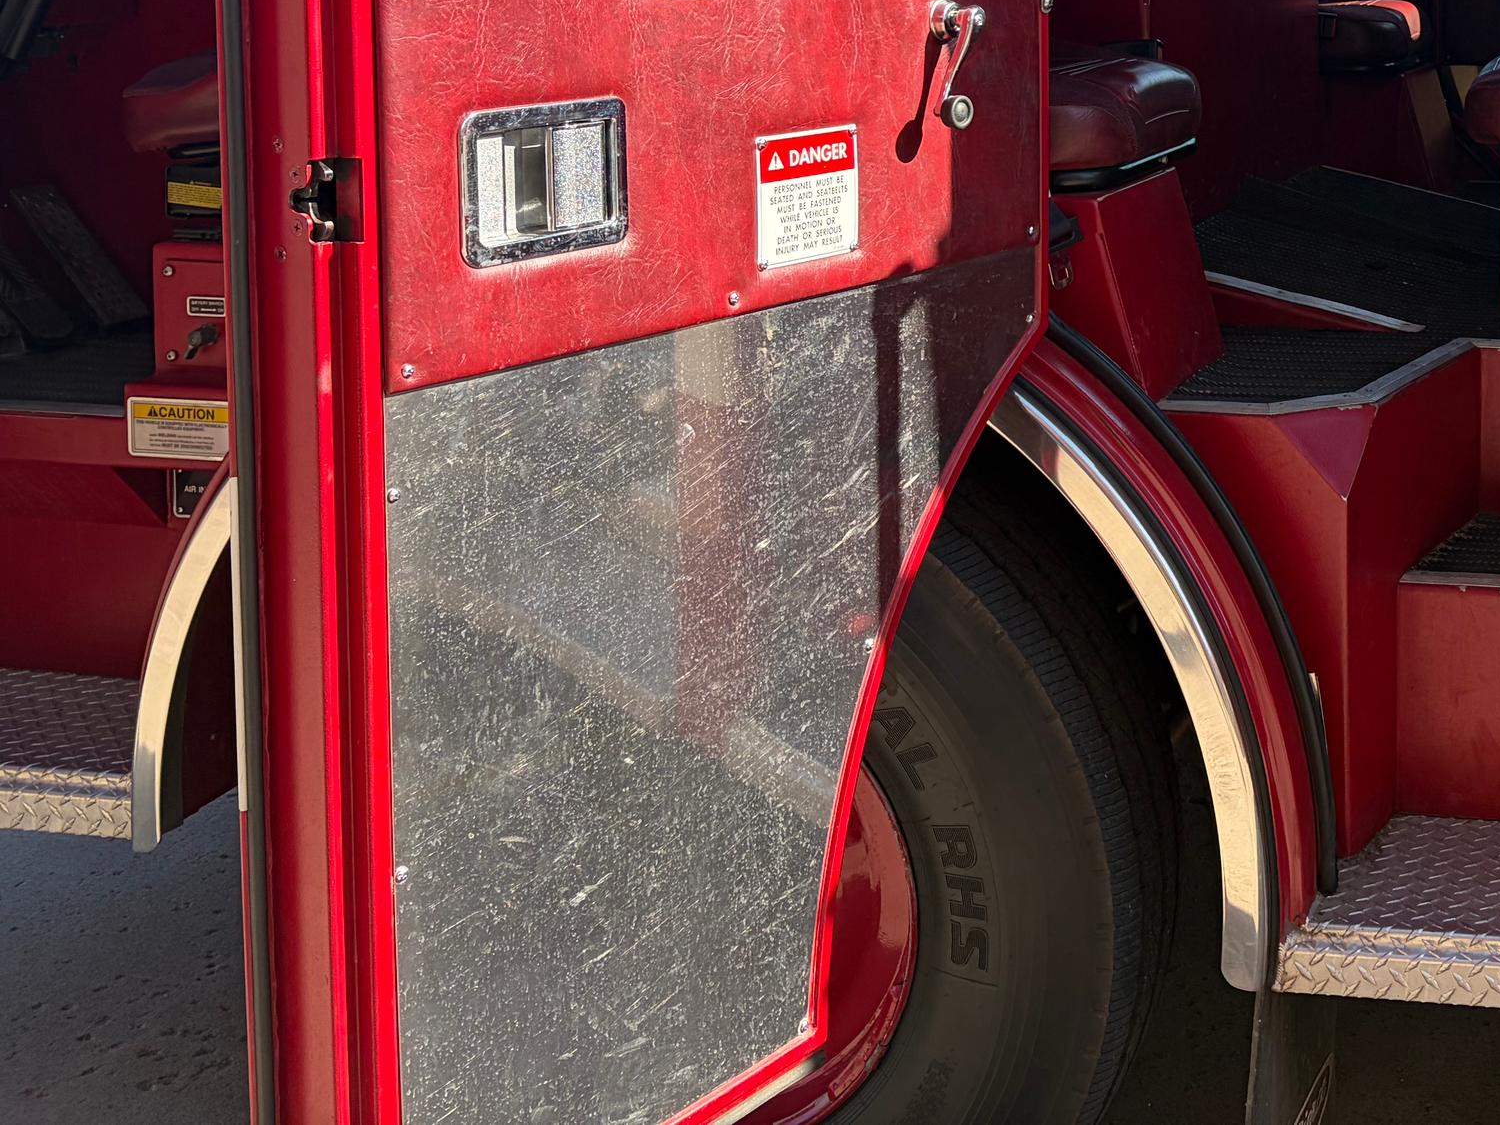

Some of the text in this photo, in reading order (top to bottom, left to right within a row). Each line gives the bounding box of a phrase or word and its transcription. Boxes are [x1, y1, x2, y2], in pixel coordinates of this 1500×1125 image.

[789, 142, 848, 167] DANGER
[774, 175, 844, 194] PERSONNEL MUST BE
[770, 184, 848, 205] SEATED AND SEATBELTS
[777, 196, 842, 215] MUST BE FASTENED
[780, 206, 839, 223] WHILE VEHICLE IS
[783, 216, 836, 234] IN MOTION OR
[777, 225, 842, 245] DEATH OR SERIOUS
[775, 234, 843, 256] INJURY MAY RESULT
[159, 406, 215, 420] CAUTION
[184, 485, 197, 494] AIR
[932, 825, 989, 972] RHS
